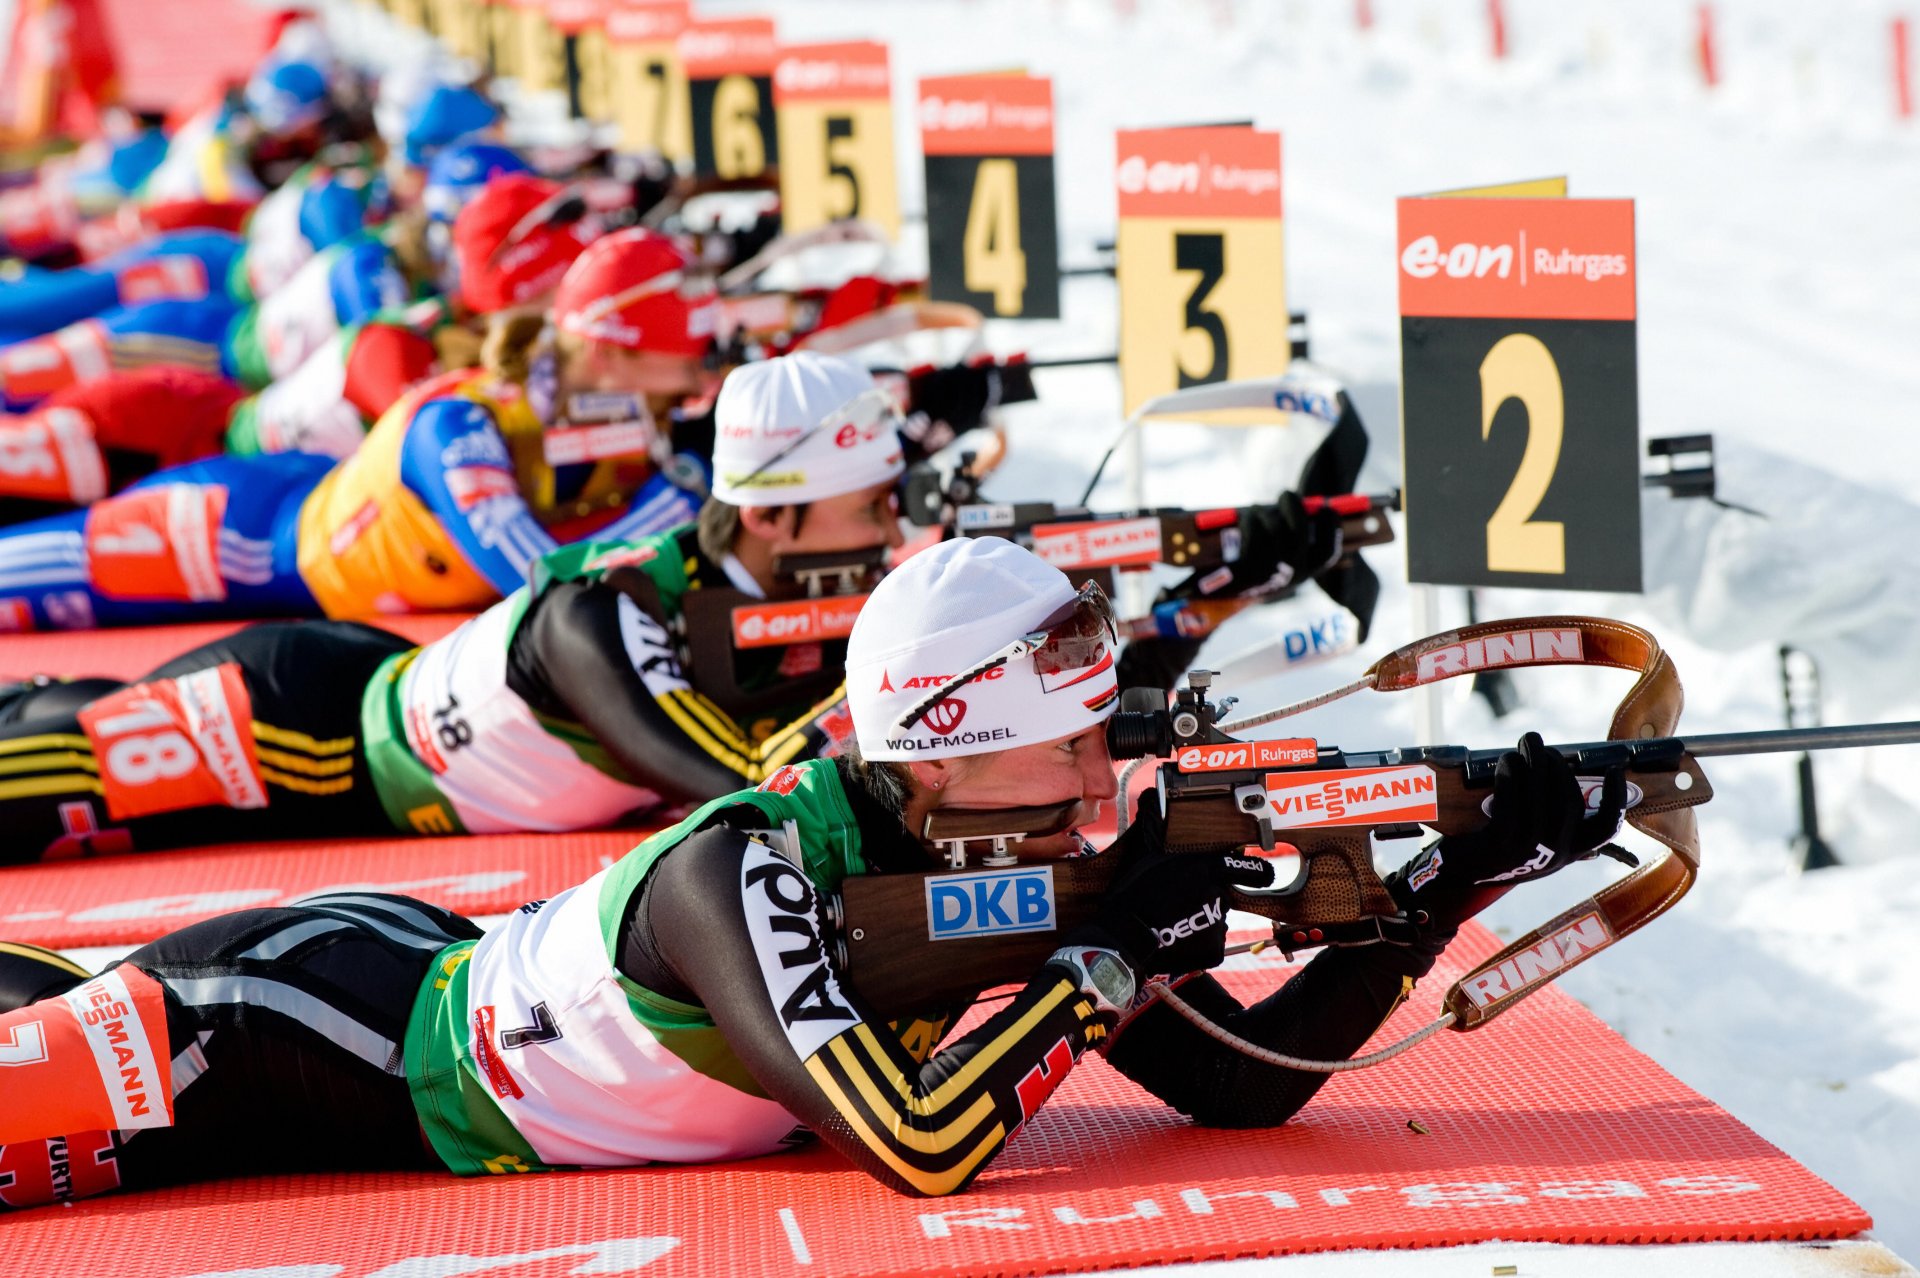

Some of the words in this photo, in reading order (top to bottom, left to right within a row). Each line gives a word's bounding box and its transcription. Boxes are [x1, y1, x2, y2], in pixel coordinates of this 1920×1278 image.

[712, 75, 766, 180] 6
[825, 115, 861, 219] 5
[963, 158, 1026, 316] 4
[1534, 248, 1628, 282] Ruhrgas
[1175, 234, 1230, 390] 3
[1479, 333, 1565, 573] 2
[1418, 630, 1581, 681] RINN
[95, 697, 200, 787] 18
[434, 691, 473, 753] 18
[886, 727, 1017, 750] WOLFMÖBEL
[1261, 746, 1316, 764] Ruhrgas
[1269, 775, 1435, 819] VIESSMANN
[931, 877, 1050, 932] DKB
[1462, 915, 1608, 1009] RINN
[82, 979, 151, 1118] VIESSMANN
[501, 1001, 564, 1050] 7
[919, 1174, 1762, 1239] Ruhrgas
